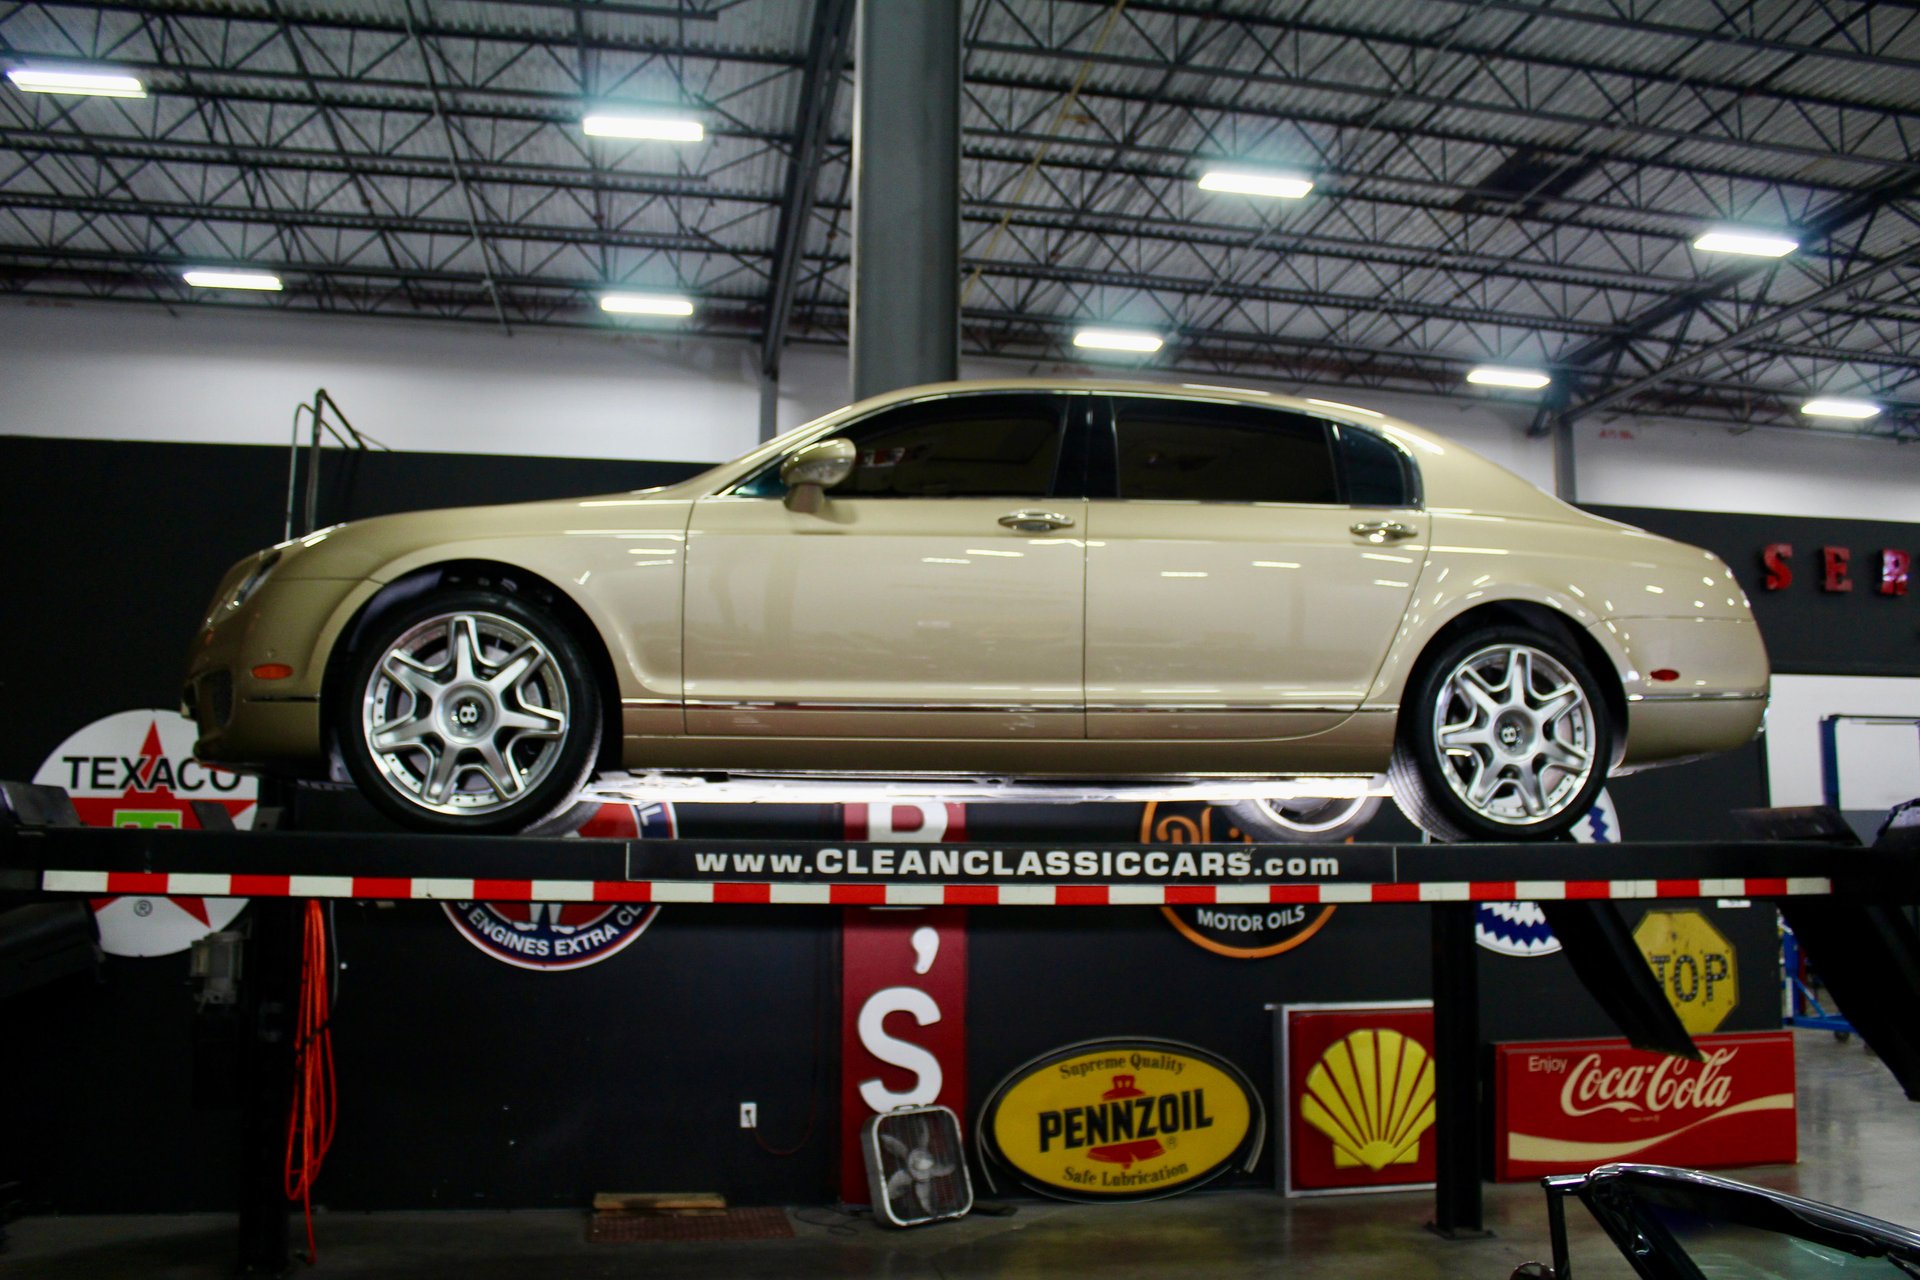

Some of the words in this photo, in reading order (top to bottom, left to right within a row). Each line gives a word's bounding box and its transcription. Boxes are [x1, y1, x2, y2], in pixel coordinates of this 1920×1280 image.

[62, 755, 242, 792] TEXACO
[695, 848, 1340, 877] www.CLEANCLASSICCARS.com
[468, 908, 550, 957] ENGINES
[554, 922, 620, 957] EXTRA
[1197, 908, 1264, 933] MOTOR
[1266, 904, 1305, 930] OILS
[1059, 1055, 1126, 1079] Supreme
[1129, 1052, 1185, 1075] Quality
[1528, 1054, 1568, 1075] Enjoy
[1560, 1046, 1740, 1117] Coca-Cola
[1038, 1088, 1214, 1153] PENNZOIL
[1063, 1165, 1097, 1186] Safe
[1101, 1162, 1189, 1187] Lubrication
